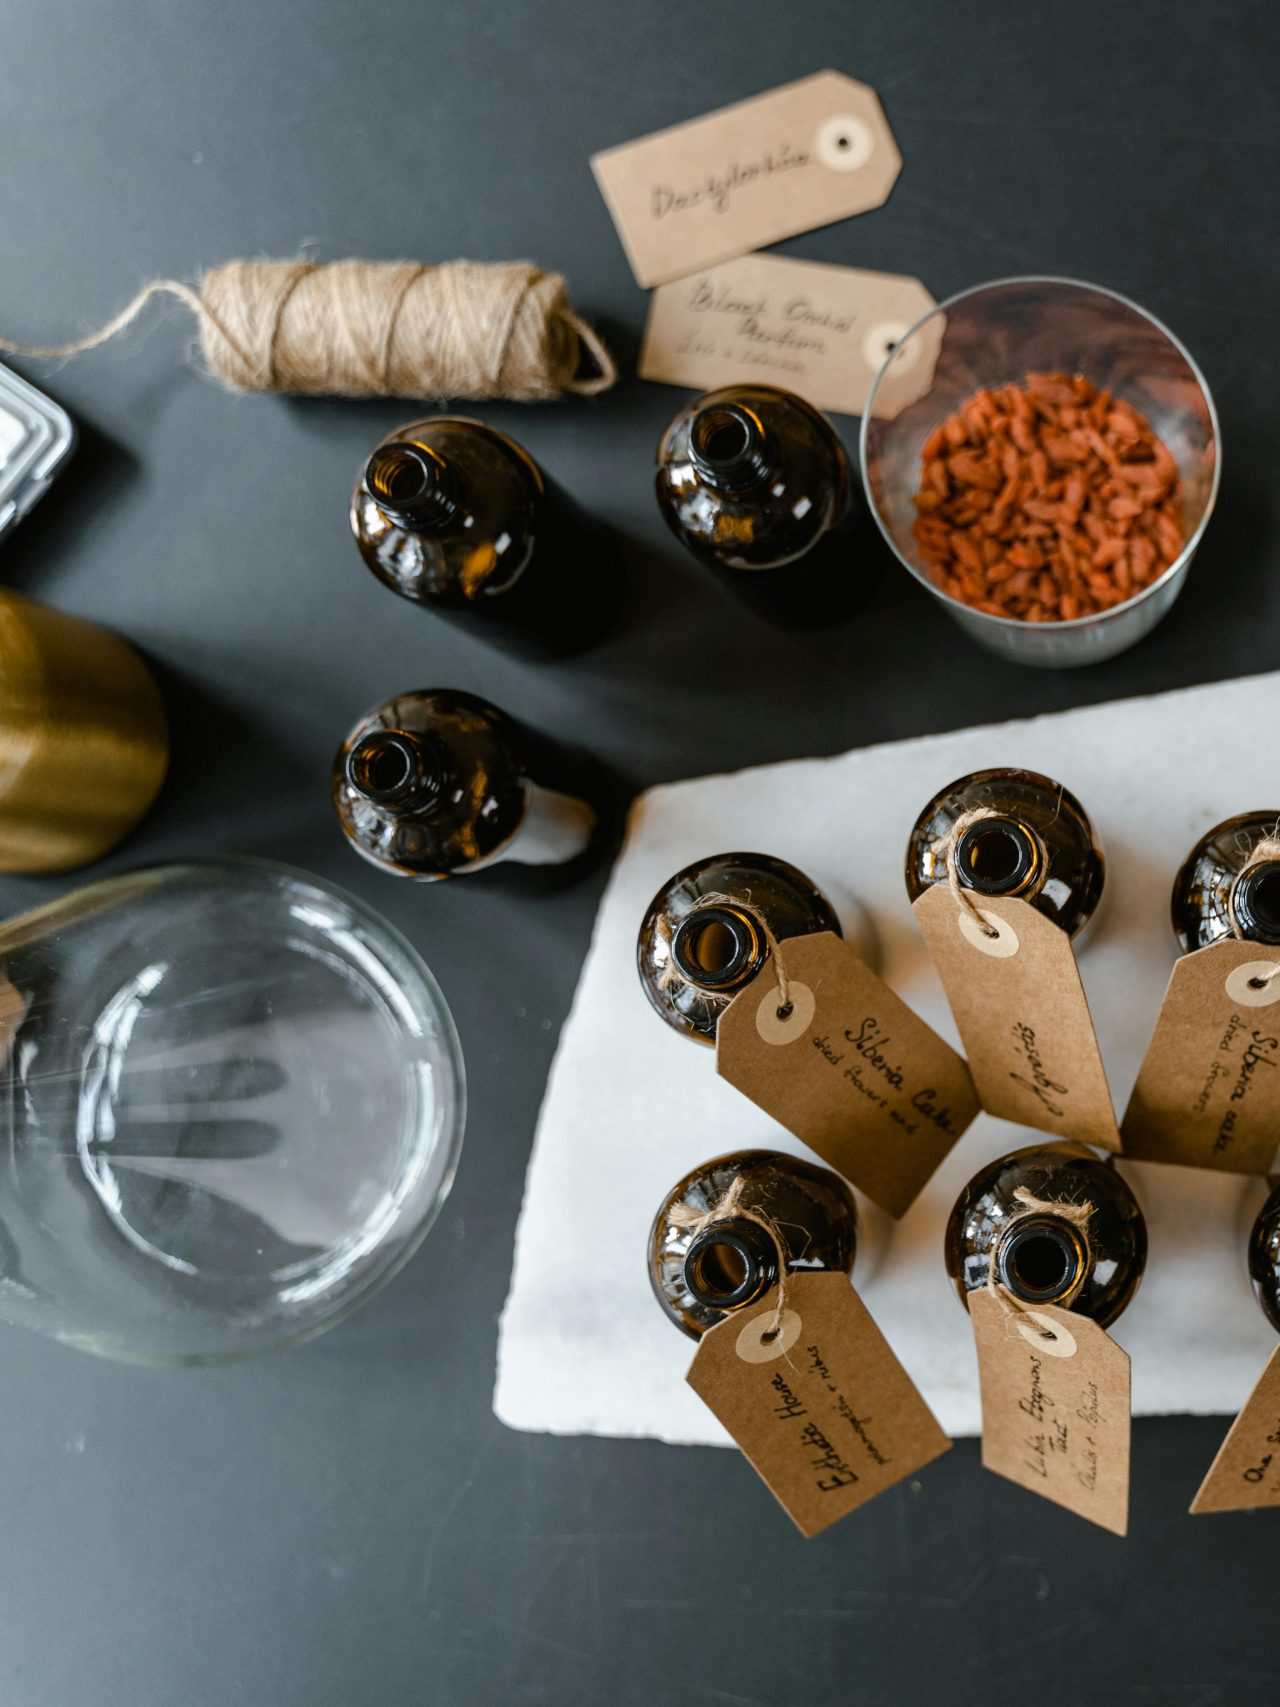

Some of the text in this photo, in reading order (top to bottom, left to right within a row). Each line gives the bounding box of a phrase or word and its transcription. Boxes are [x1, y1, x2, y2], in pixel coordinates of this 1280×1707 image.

[813, 1037, 844, 1067] dried
[1219, 1015, 1247, 1052] dried
[844, 1018, 954, 1135] Siberia Cake
[1231, 1031, 1278, 1101] Siberia
[771, 1372, 807, 1420] House
